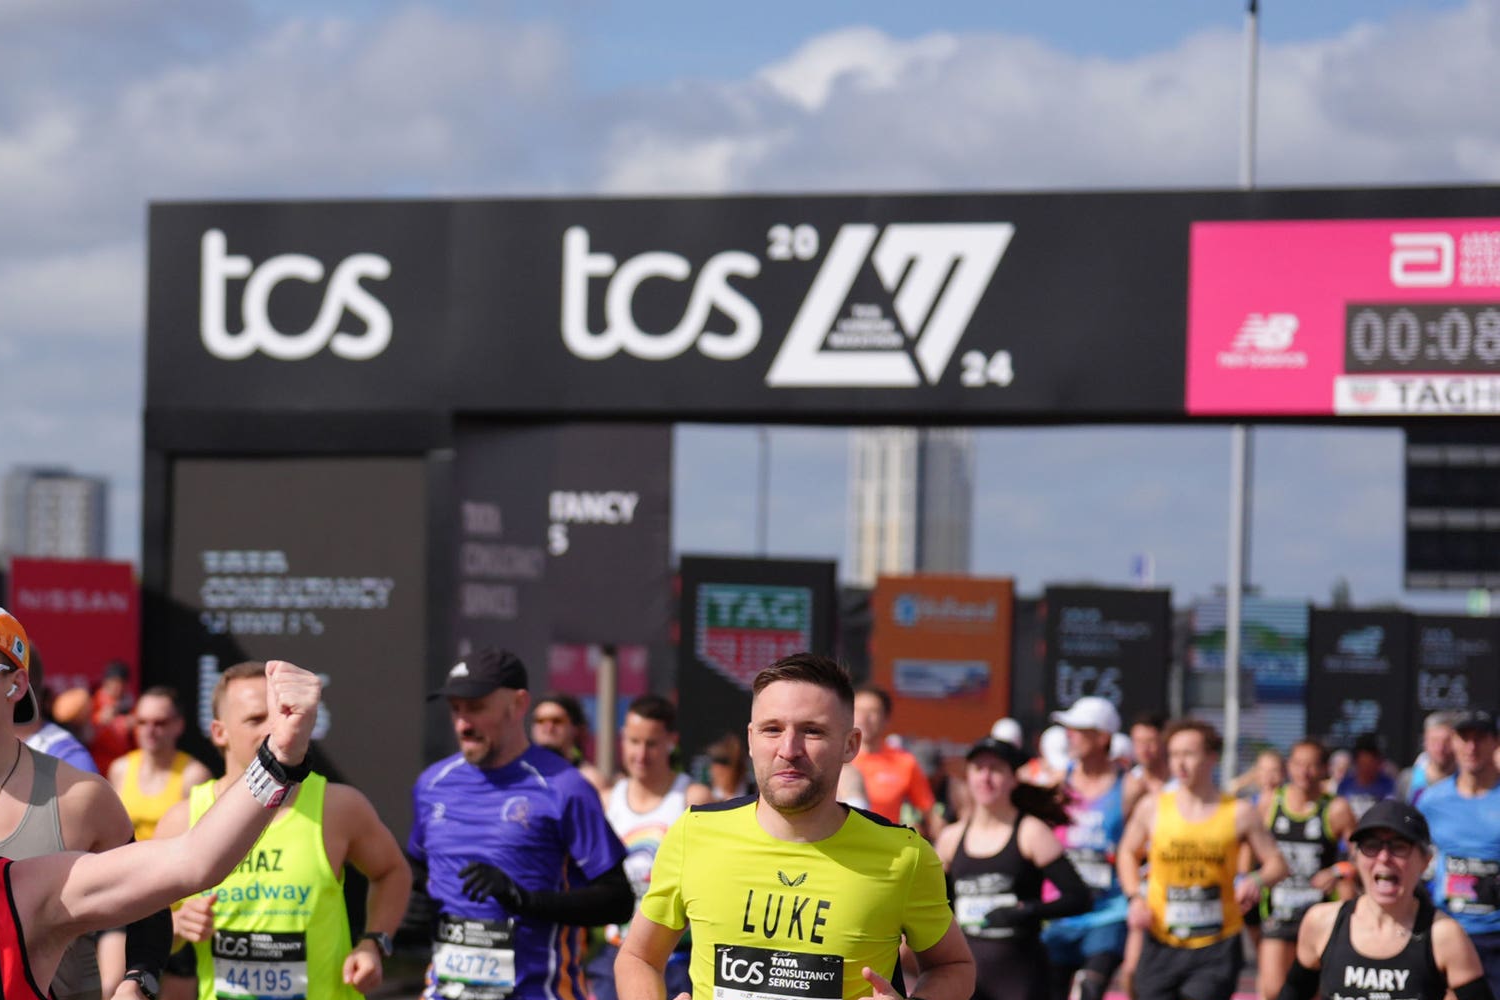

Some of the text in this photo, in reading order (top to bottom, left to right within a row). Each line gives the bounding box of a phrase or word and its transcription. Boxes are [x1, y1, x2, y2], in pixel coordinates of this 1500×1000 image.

[766, 224, 819, 260] 20
[201, 228, 393, 360] tcs
[561, 225, 762, 360] tcs
[960, 350, 1014, 387] 24
[550, 491, 638, 524] FANCY
[712, 591, 798, 626] TAG
[237, 849, 284, 873] HAZ
[742, 889, 831, 944] LUKE
[215, 931, 248, 956] tcs
[721, 951, 764, 985] tcs
[769, 967, 835, 981] CONSULTANCY
[770, 956, 799, 968] TATA
[1344, 965, 1410, 991] MARY
[226, 967, 292, 992] 44195
[768, 977, 811, 990] SERVICES
